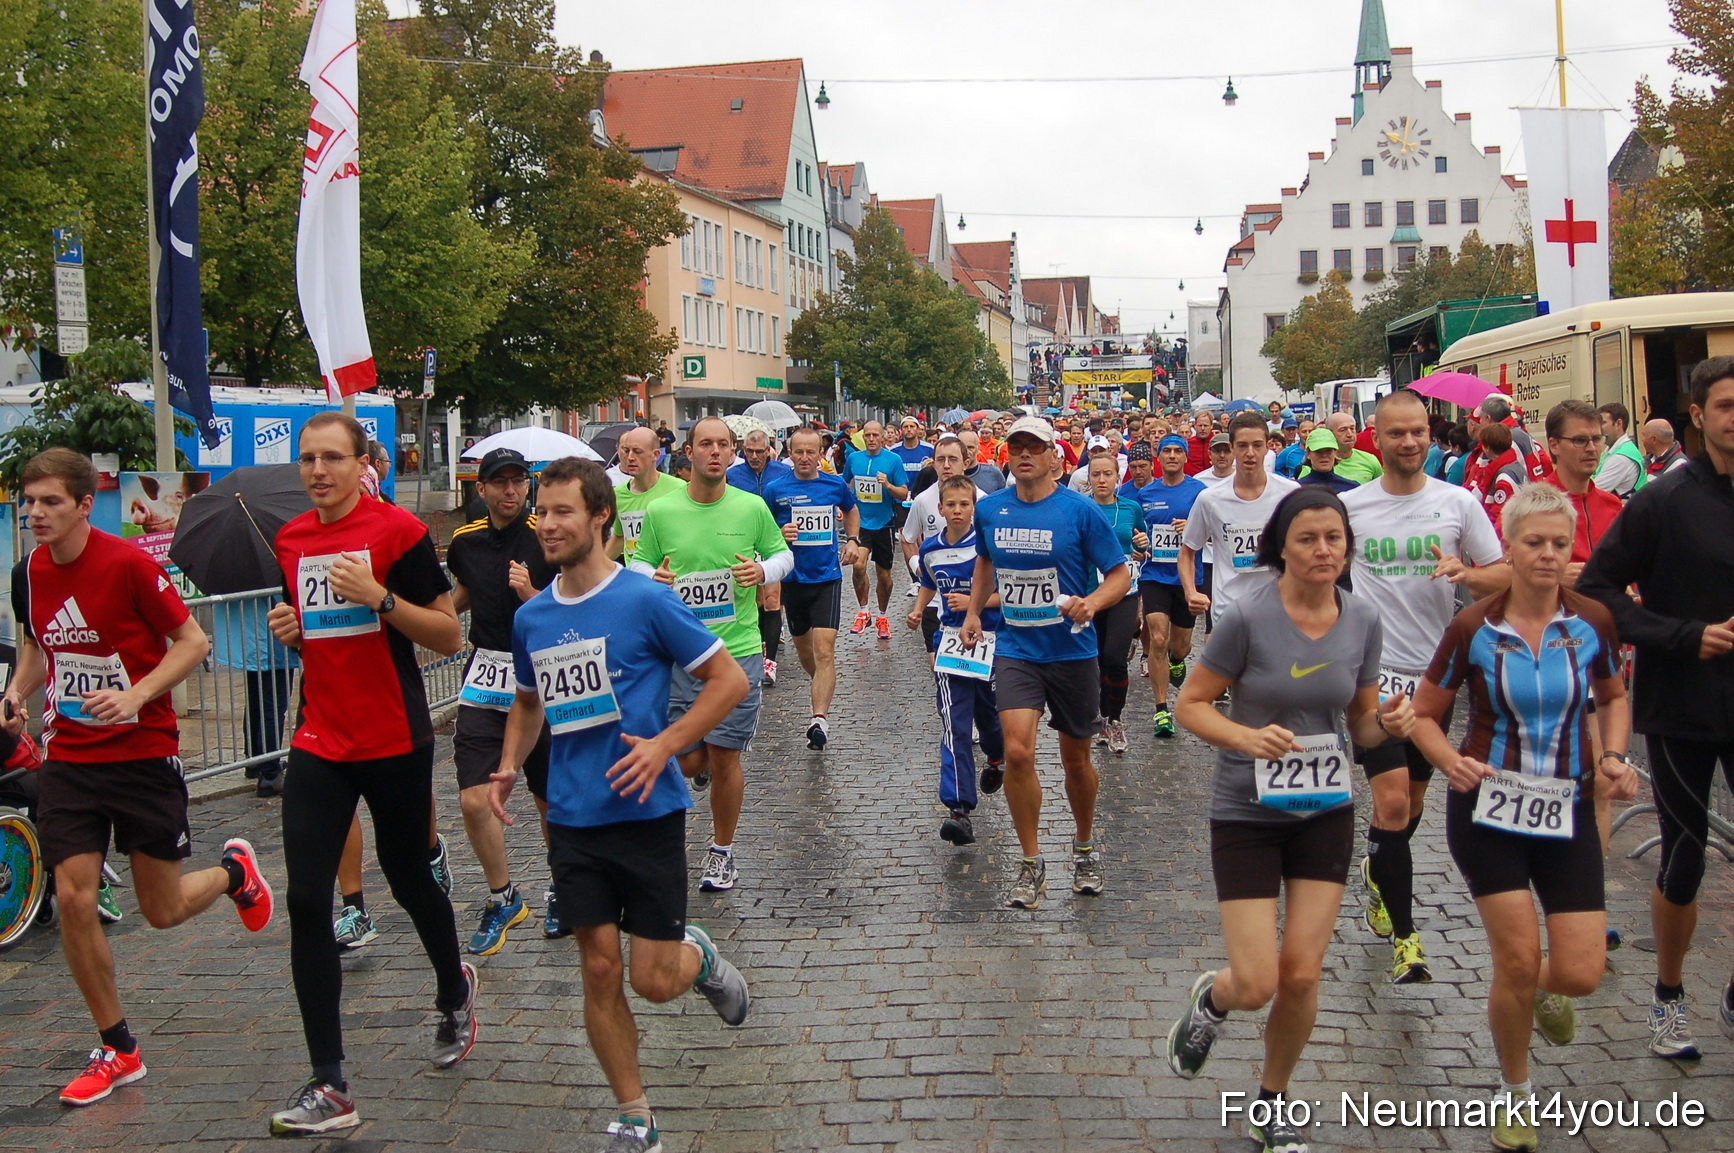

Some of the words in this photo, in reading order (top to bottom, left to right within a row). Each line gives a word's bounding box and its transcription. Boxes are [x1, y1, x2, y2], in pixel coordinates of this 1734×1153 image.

[428, 354, 434, 374] P
[687, 359, 702, 375] D
[1517, 353, 1566, 380] Bayerisches
[1092, 373, 1121, 381] START
[1517, 382, 1540, 401] Rotes
[1523, 409, 1539, 424] euz
[401, 434, 416, 443] STREB
[860, 482, 875, 493] 241
[797, 515, 830, 530] 2610
[994, 527, 1053, 543] HUBER
[1155, 534, 1183, 548] 244
[1006, 541, 1049, 549] TECHNOLOGY
[1364, 537, 1396, 562] GO
[1406, 534, 1441, 561] 09
[300, 564, 321, 573] PARTL
[1387, 566, 1407, 576] RUN
[695, 575, 722, 583] Neumarkt
[680, 582, 729, 605] 2942
[1004, 583, 1054, 604] 2776
[320, 613, 351, 626] Martin
[692, 608, 725, 618] hristoph
[1012, 609, 1047, 619] Matthias
[43, 627, 100, 646] adidas
[56, 659, 79, 669] PARTL
[80, 662, 112, 671] Neumarkt
[534, 657, 553, 668] PARTL
[554, 649, 591, 664] Neumarkt
[957, 661, 970, 670] Jan
[473, 664, 515, 688] 291
[607, 669, 622, 677] auf
[63, 671, 124, 697] 2075
[540, 660, 602, 702] 2430
[1379, 673, 1415, 701] 264
[476, 692, 511, 705] Andreas
[555, 702, 595, 721] Gerhard
[1292, 744, 1333, 753] umarkt
[1266, 755, 1341, 789] 2212
[1484, 776, 1514, 788] PARTL
[1517, 782, 1559, 795] Neumarkt
[1287, 798, 1320, 809] Heike
[1486, 790, 1562, 830] 2198
